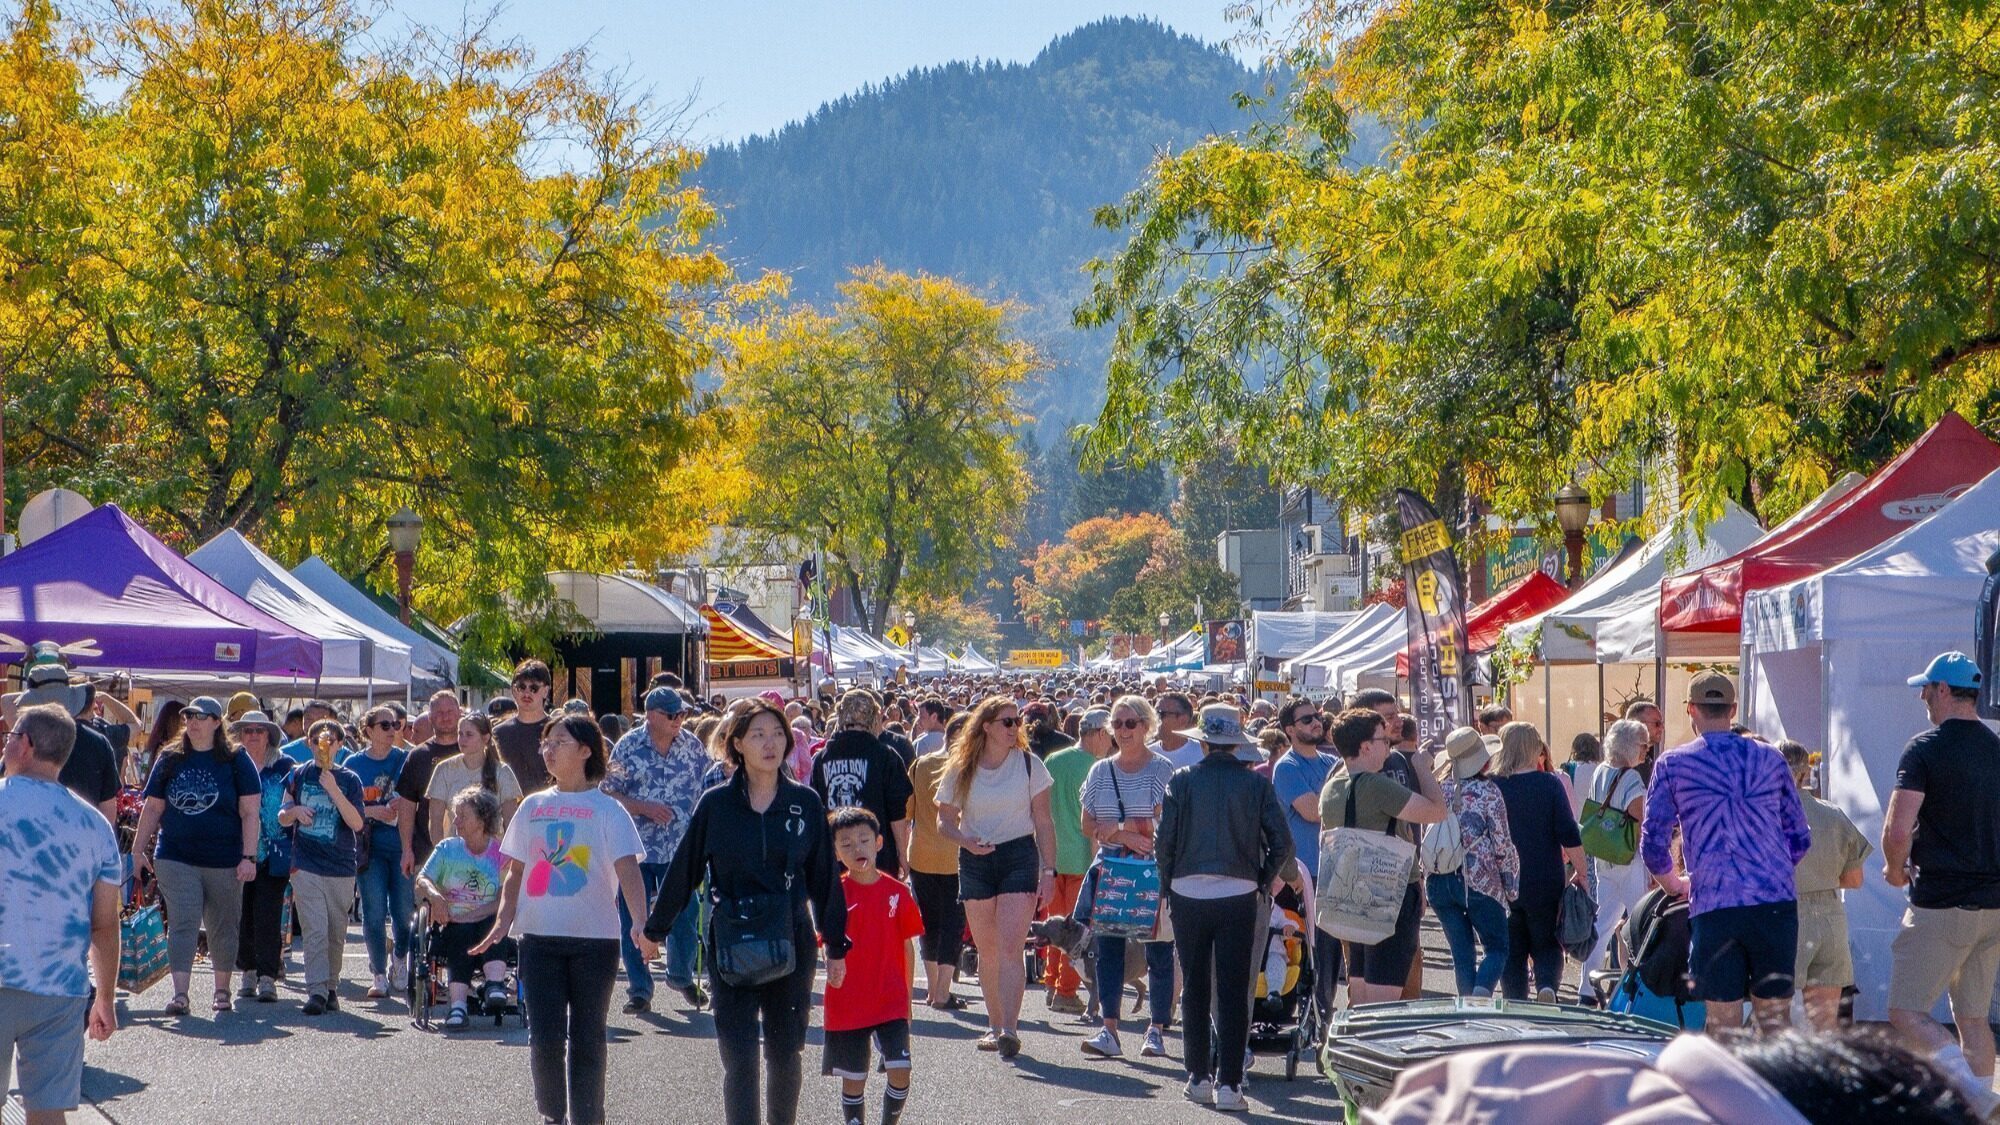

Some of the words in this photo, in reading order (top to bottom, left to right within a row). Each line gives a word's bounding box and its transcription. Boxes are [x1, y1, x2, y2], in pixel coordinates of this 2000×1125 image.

[1406, 524, 1439, 549] FREE
[1491, 548, 1541, 591] Sherwood
[734, 661, 778, 677] NUTS
[1419, 656, 1428, 683] GOT
[1440, 623, 1459, 724] TRIST
[1420, 687, 1428, 714] YOU
[823, 759, 849, 787] DEATH
[849, 758, 868, 784] ROW
[530, 804, 555, 818] LIKE
[558, 805, 593, 819] EVER
